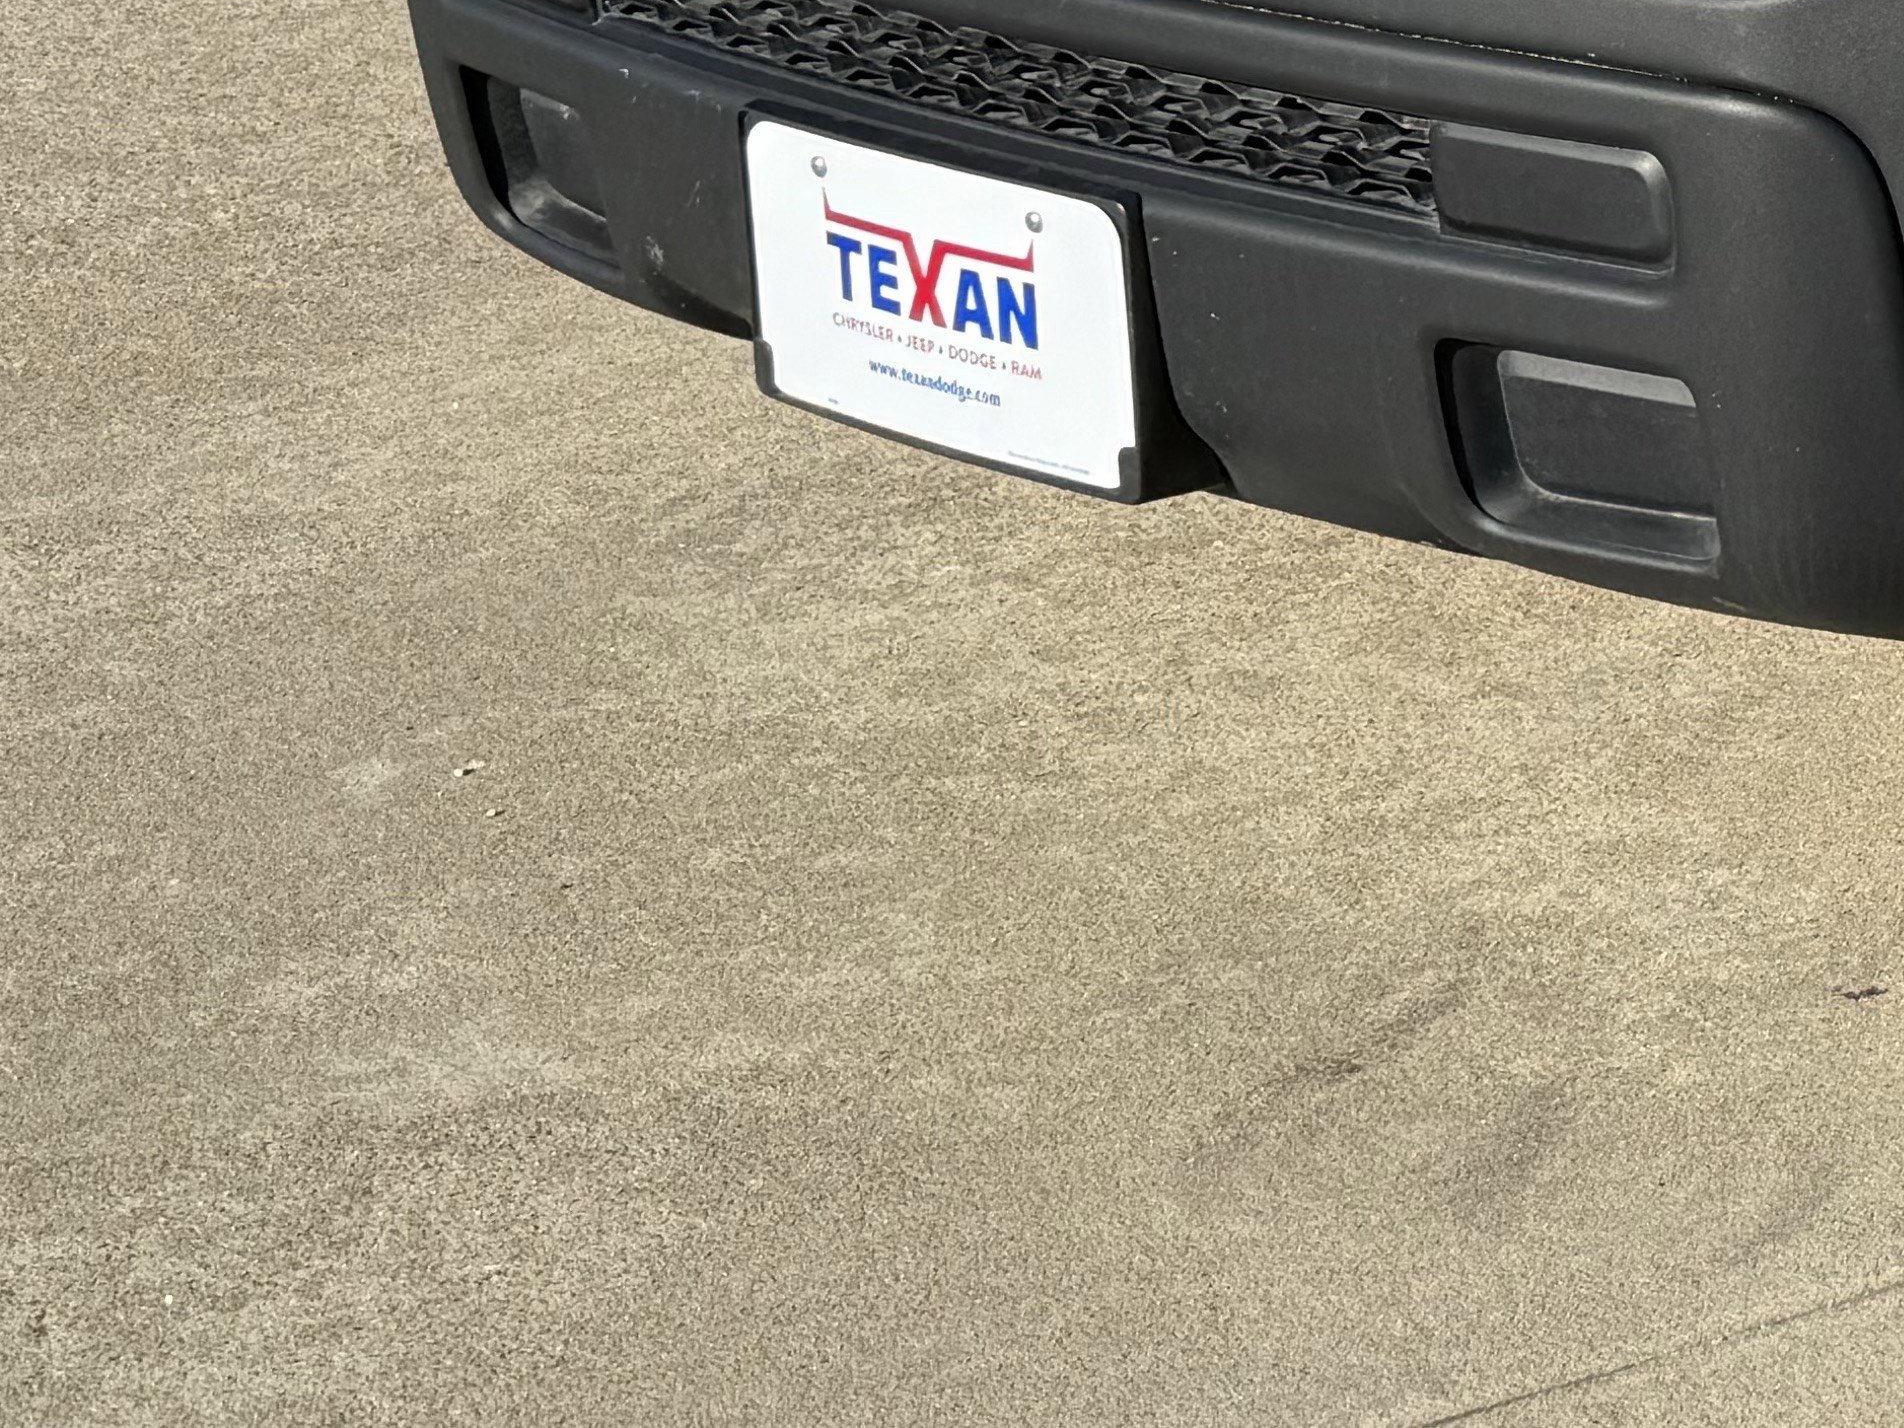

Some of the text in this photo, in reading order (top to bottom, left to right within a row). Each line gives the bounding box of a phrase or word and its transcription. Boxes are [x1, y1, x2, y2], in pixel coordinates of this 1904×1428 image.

[825, 230, 1039, 351] TEXAN
[832, 312, 1043, 380] CHRYSLER JEEP DODGE RAM
